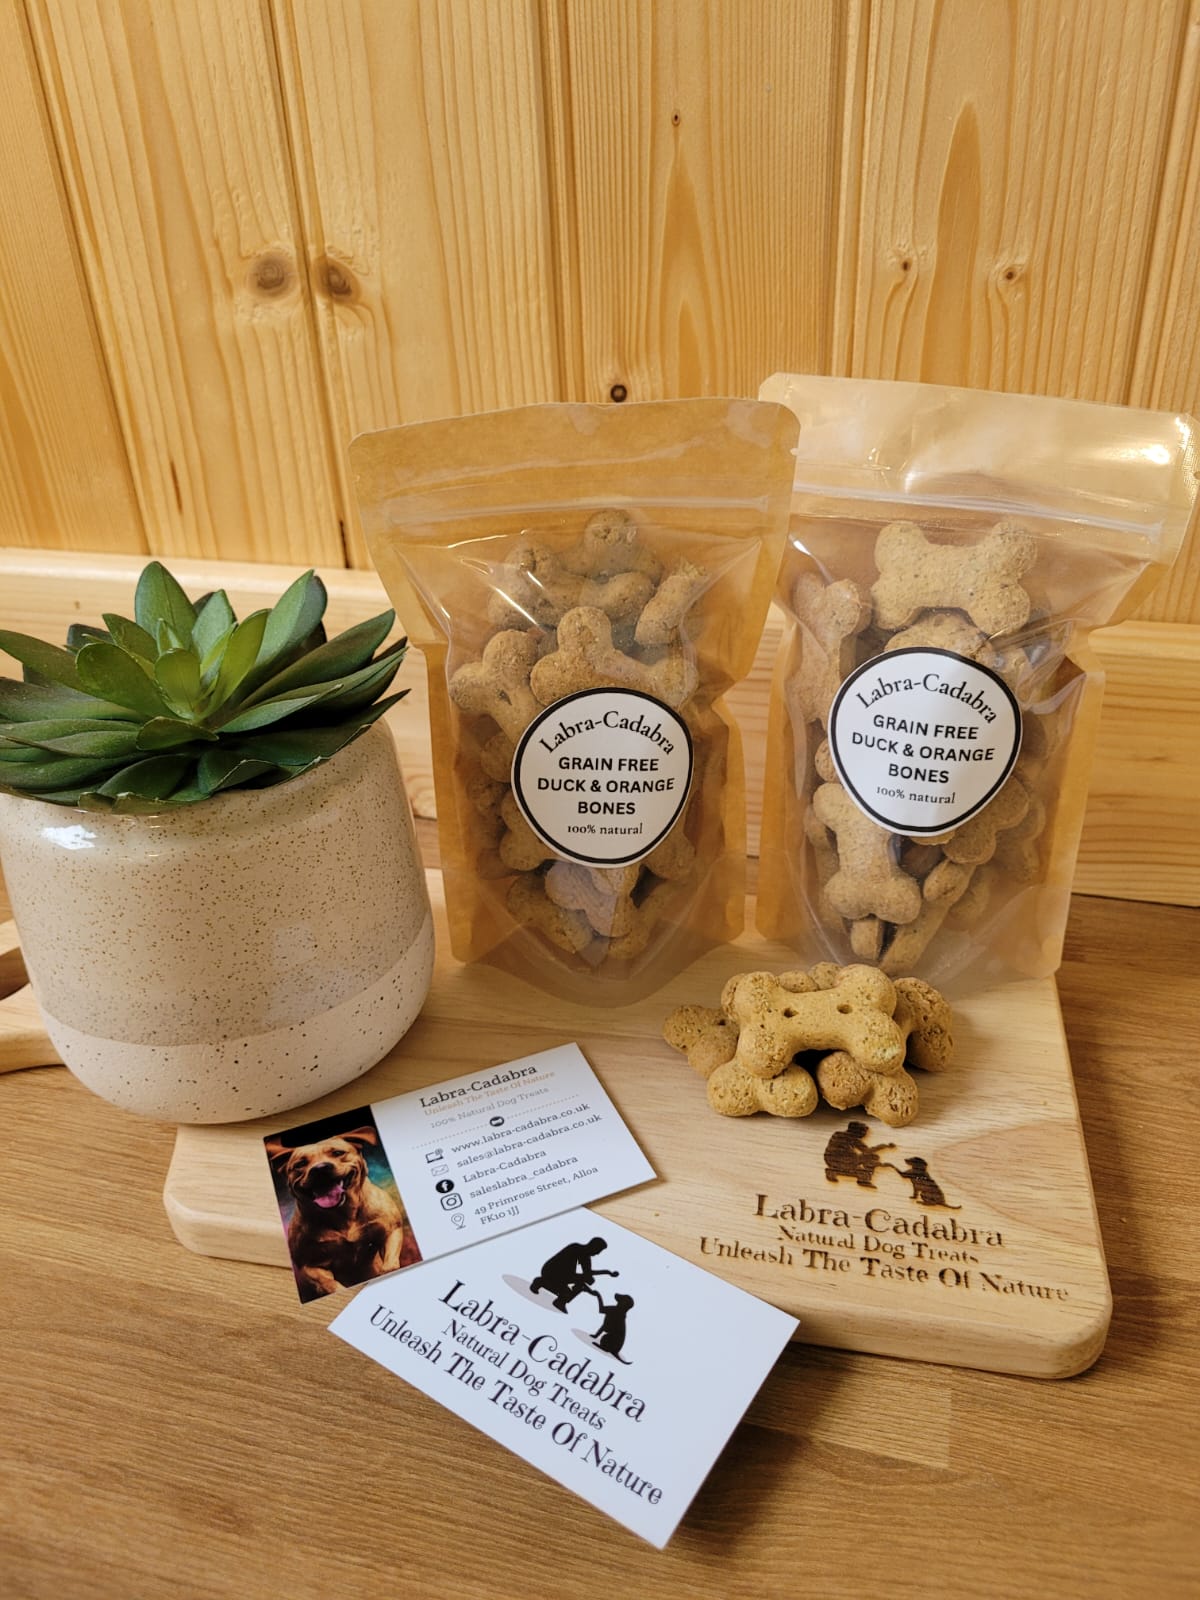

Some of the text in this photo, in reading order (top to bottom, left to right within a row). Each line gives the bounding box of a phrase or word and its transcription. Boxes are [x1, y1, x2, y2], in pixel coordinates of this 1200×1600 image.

[856, 673, 997, 724] Labra-Cadabra
[539, 711, 675, 755] Labra-Cadabra
[852, 732, 995, 762] DUCK & ORANGE
[873, 714, 979, 739] GRAIN FREE
[538, 778, 675, 793] DUCK & ORANGE
[559, 757, 659, 771] GRAIN FREE
[889, 764, 949, 783] BONES
[578, 801, 635, 815] BONES
[876, 787, 956, 804] 100% natural
[567, 823, 643, 835] 100% natural
[419, 1065, 538, 1108] Labra-Cadabra
[424, 1071, 555, 1116] Unleash The Taste Of Nature
[431, 1087, 549, 1128] 100% Natural Dog Treats
[452, 1102, 590, 1153] www.labra-cadabra.co.uk
[457, 1114, 602, 1168] sales@labra-cadabra.co.uk
[462, 1149, 547, 1183] Labra-Cadabra
[470, 1156, 578, 1199] saleslabra_cadabra
[474, 1167, 599, 1216] 49 Primrose Street, Alloa
[753, 1194, 1005, 1247] Labra-Cadabra
[777, 1225, 980, 1263] Natural Dog Treats
[700, 1236, 1069, 1301] Unleash The Taste Of Nature
[438, 1279, 646, 1423] Labra-Cadabra
[441, 1319, 607, 1430] Natural Dog Treats
[370, 1304, 664, 1505] Unleash The Taste Of Nature
